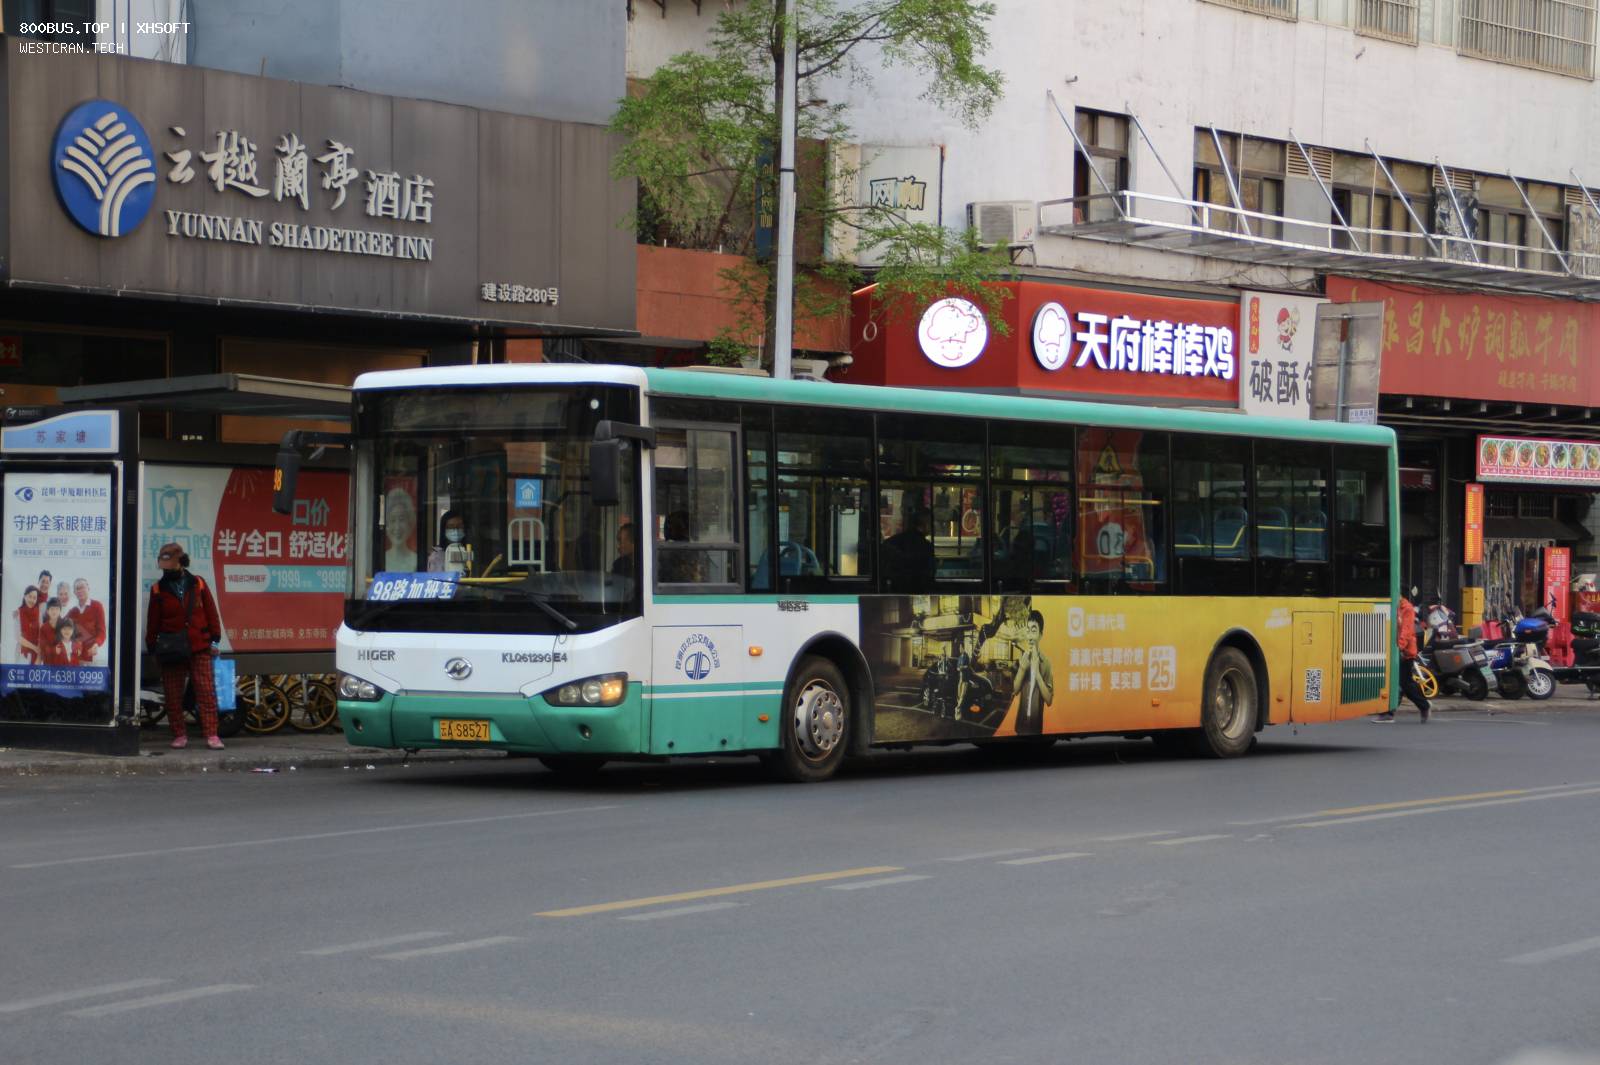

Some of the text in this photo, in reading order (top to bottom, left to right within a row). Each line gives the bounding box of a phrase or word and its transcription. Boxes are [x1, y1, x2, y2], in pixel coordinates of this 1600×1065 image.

[165, 209, 435, 261] YUNNAN SHADETREE INN
[481, 283, 560, 306] 建设路280号
[1074, 311, 1236, 379] 天府棒棒鸡
[13, 514, 107, 533] 守护全家眼健康
[217, 528, 283, 558] 半/全口
[357, 649, 396, 661] HIGER
[502, 652, 568, 664] KLQ6129GE4
[28, 669, 76, 683] 0871-6381
[79, 671, 104, 684] 9999
